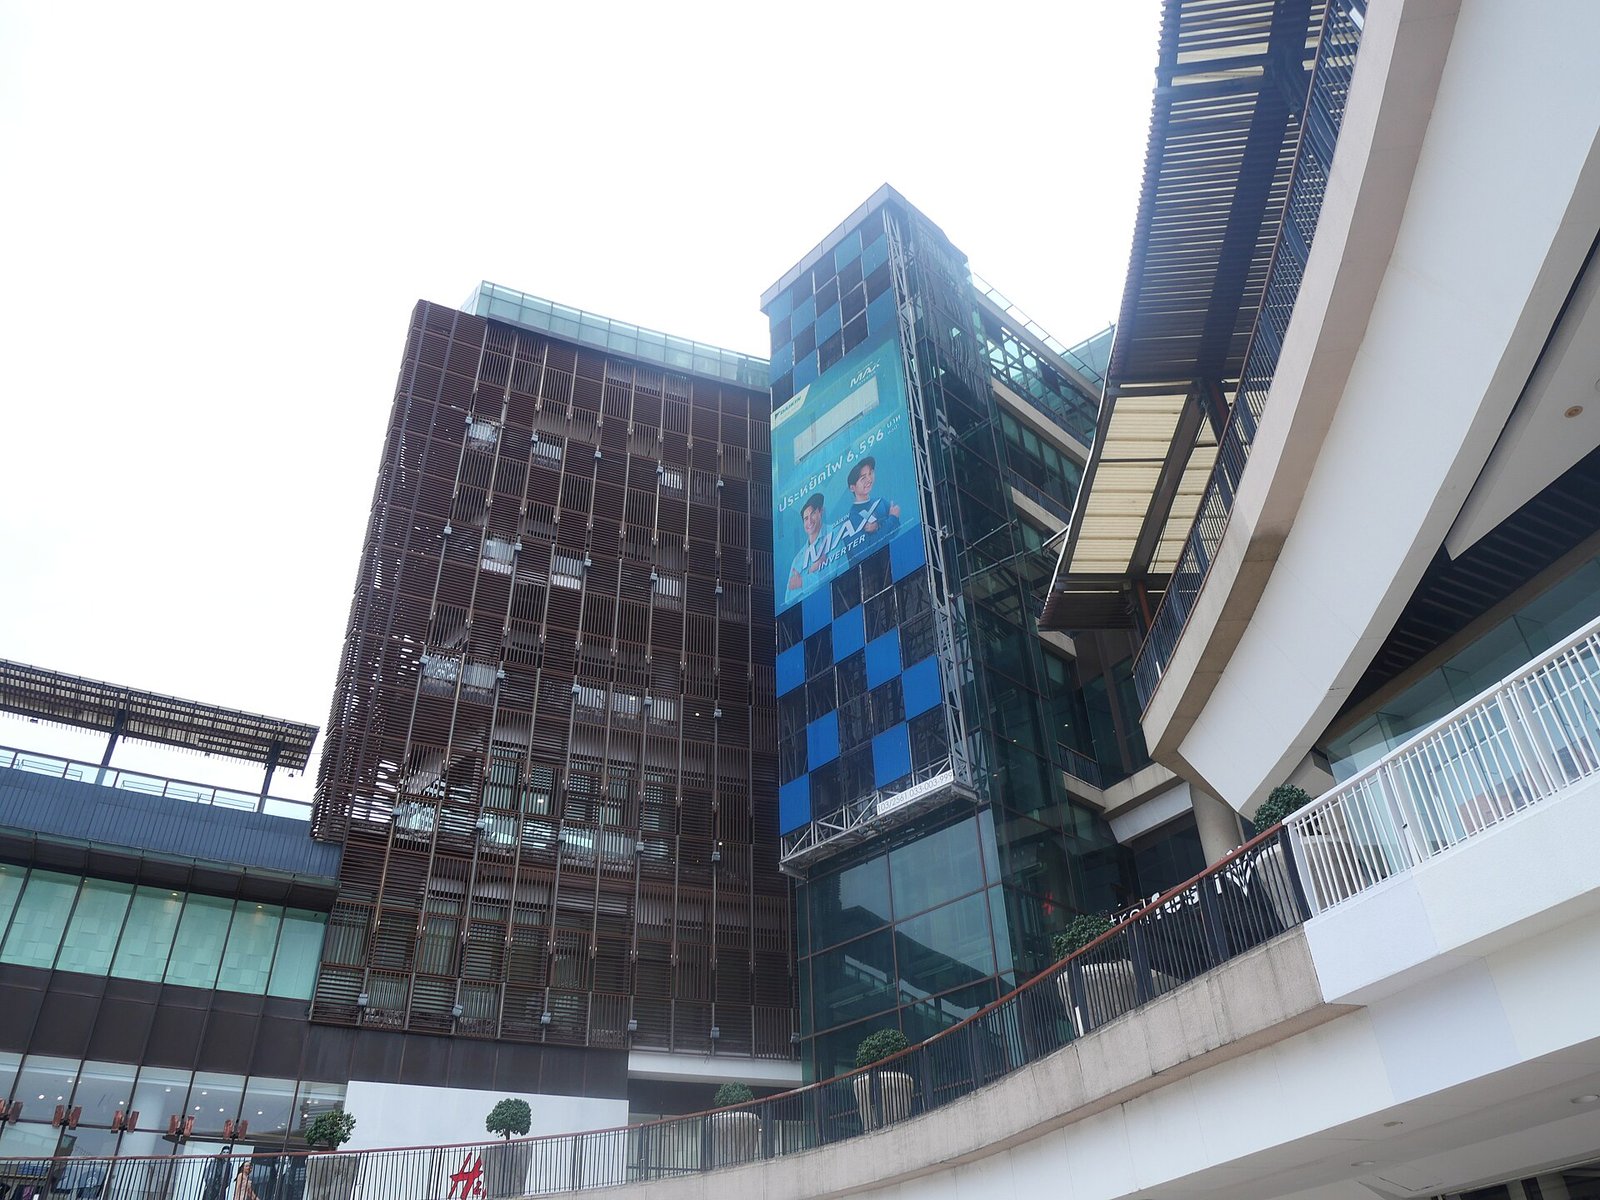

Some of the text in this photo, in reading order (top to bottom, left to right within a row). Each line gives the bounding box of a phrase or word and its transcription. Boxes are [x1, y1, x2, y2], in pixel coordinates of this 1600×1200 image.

[777, 456, 843, 512] ประหยัดไฟ
[846, 429, 884, 462] 6,596
[802, 498, 881, 570] MAX
[818, 534, 867, 571] INVERTER
[447, 1151, 487, 1200] H&
